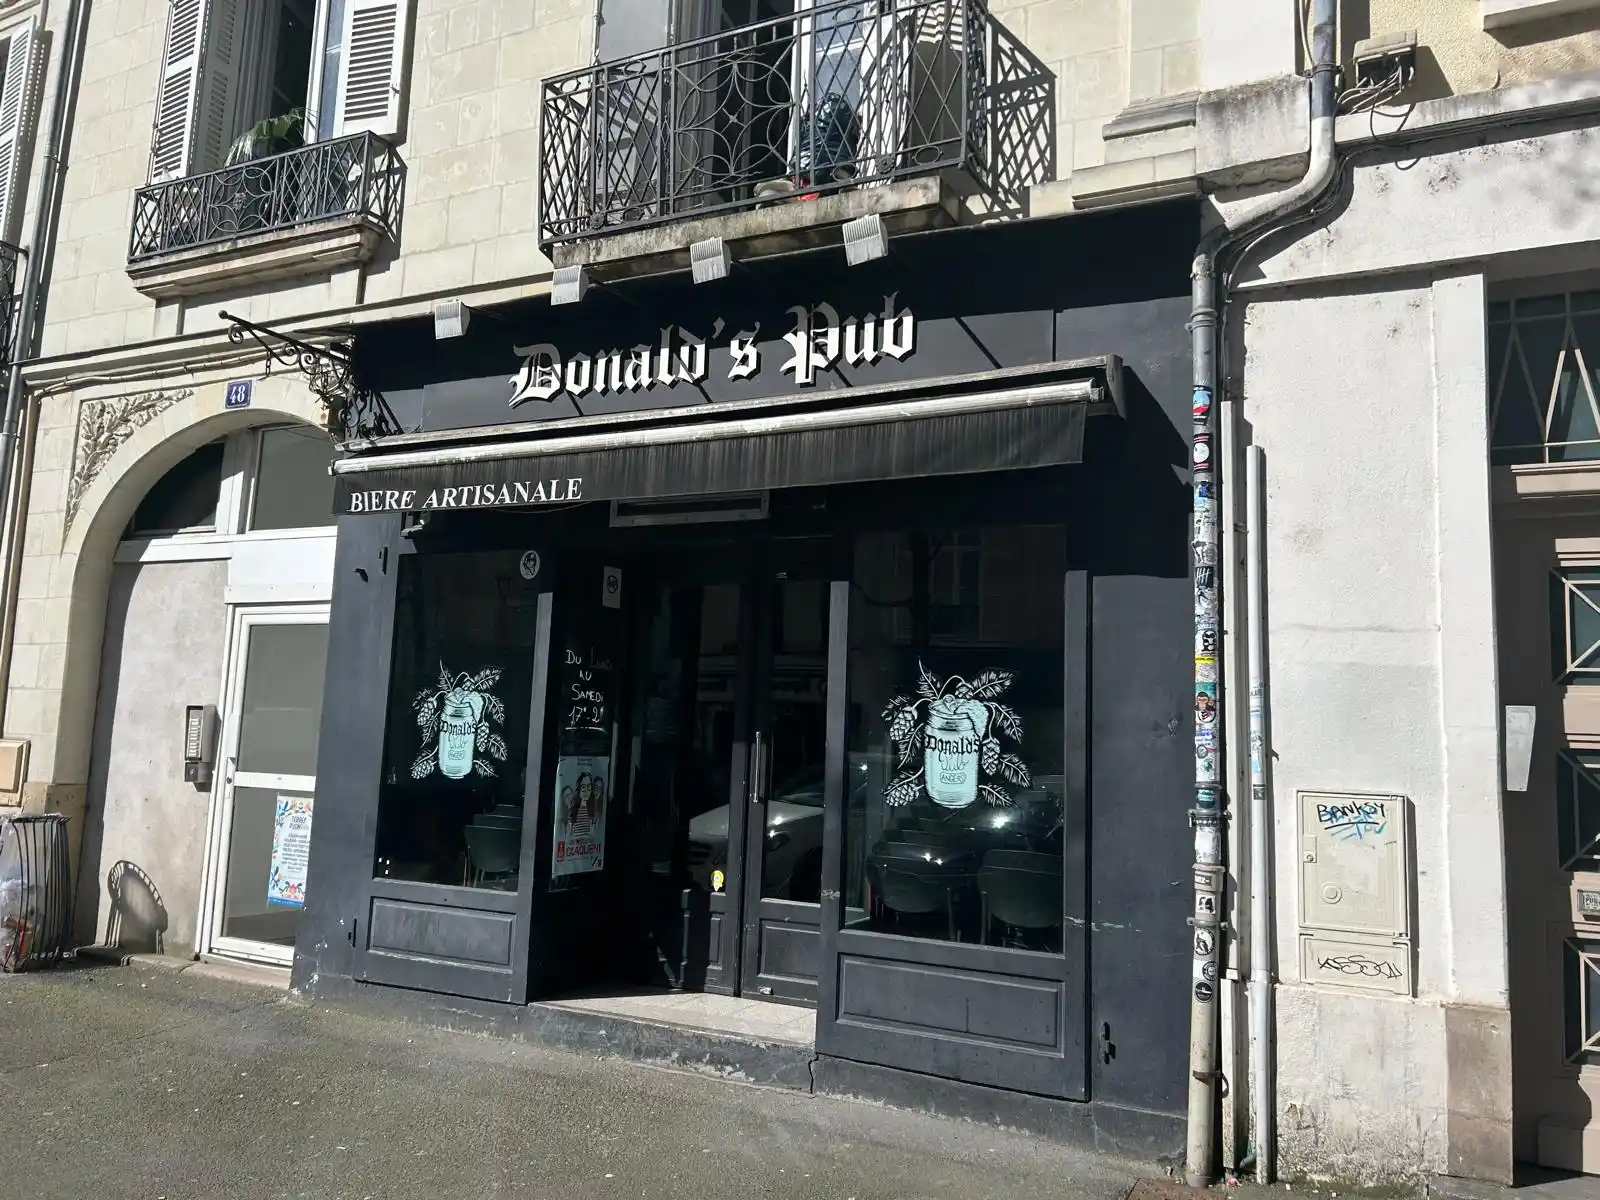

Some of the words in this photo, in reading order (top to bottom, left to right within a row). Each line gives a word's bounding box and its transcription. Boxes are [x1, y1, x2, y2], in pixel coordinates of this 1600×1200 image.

[508, 316, 762, 409] Donald's
[780, 291, 916, 386] Pub
[229, 385, 246, 403] 48
[348, 489, 416, 513] BIERE
[421, 476, 583, 509] ARTISANALE
